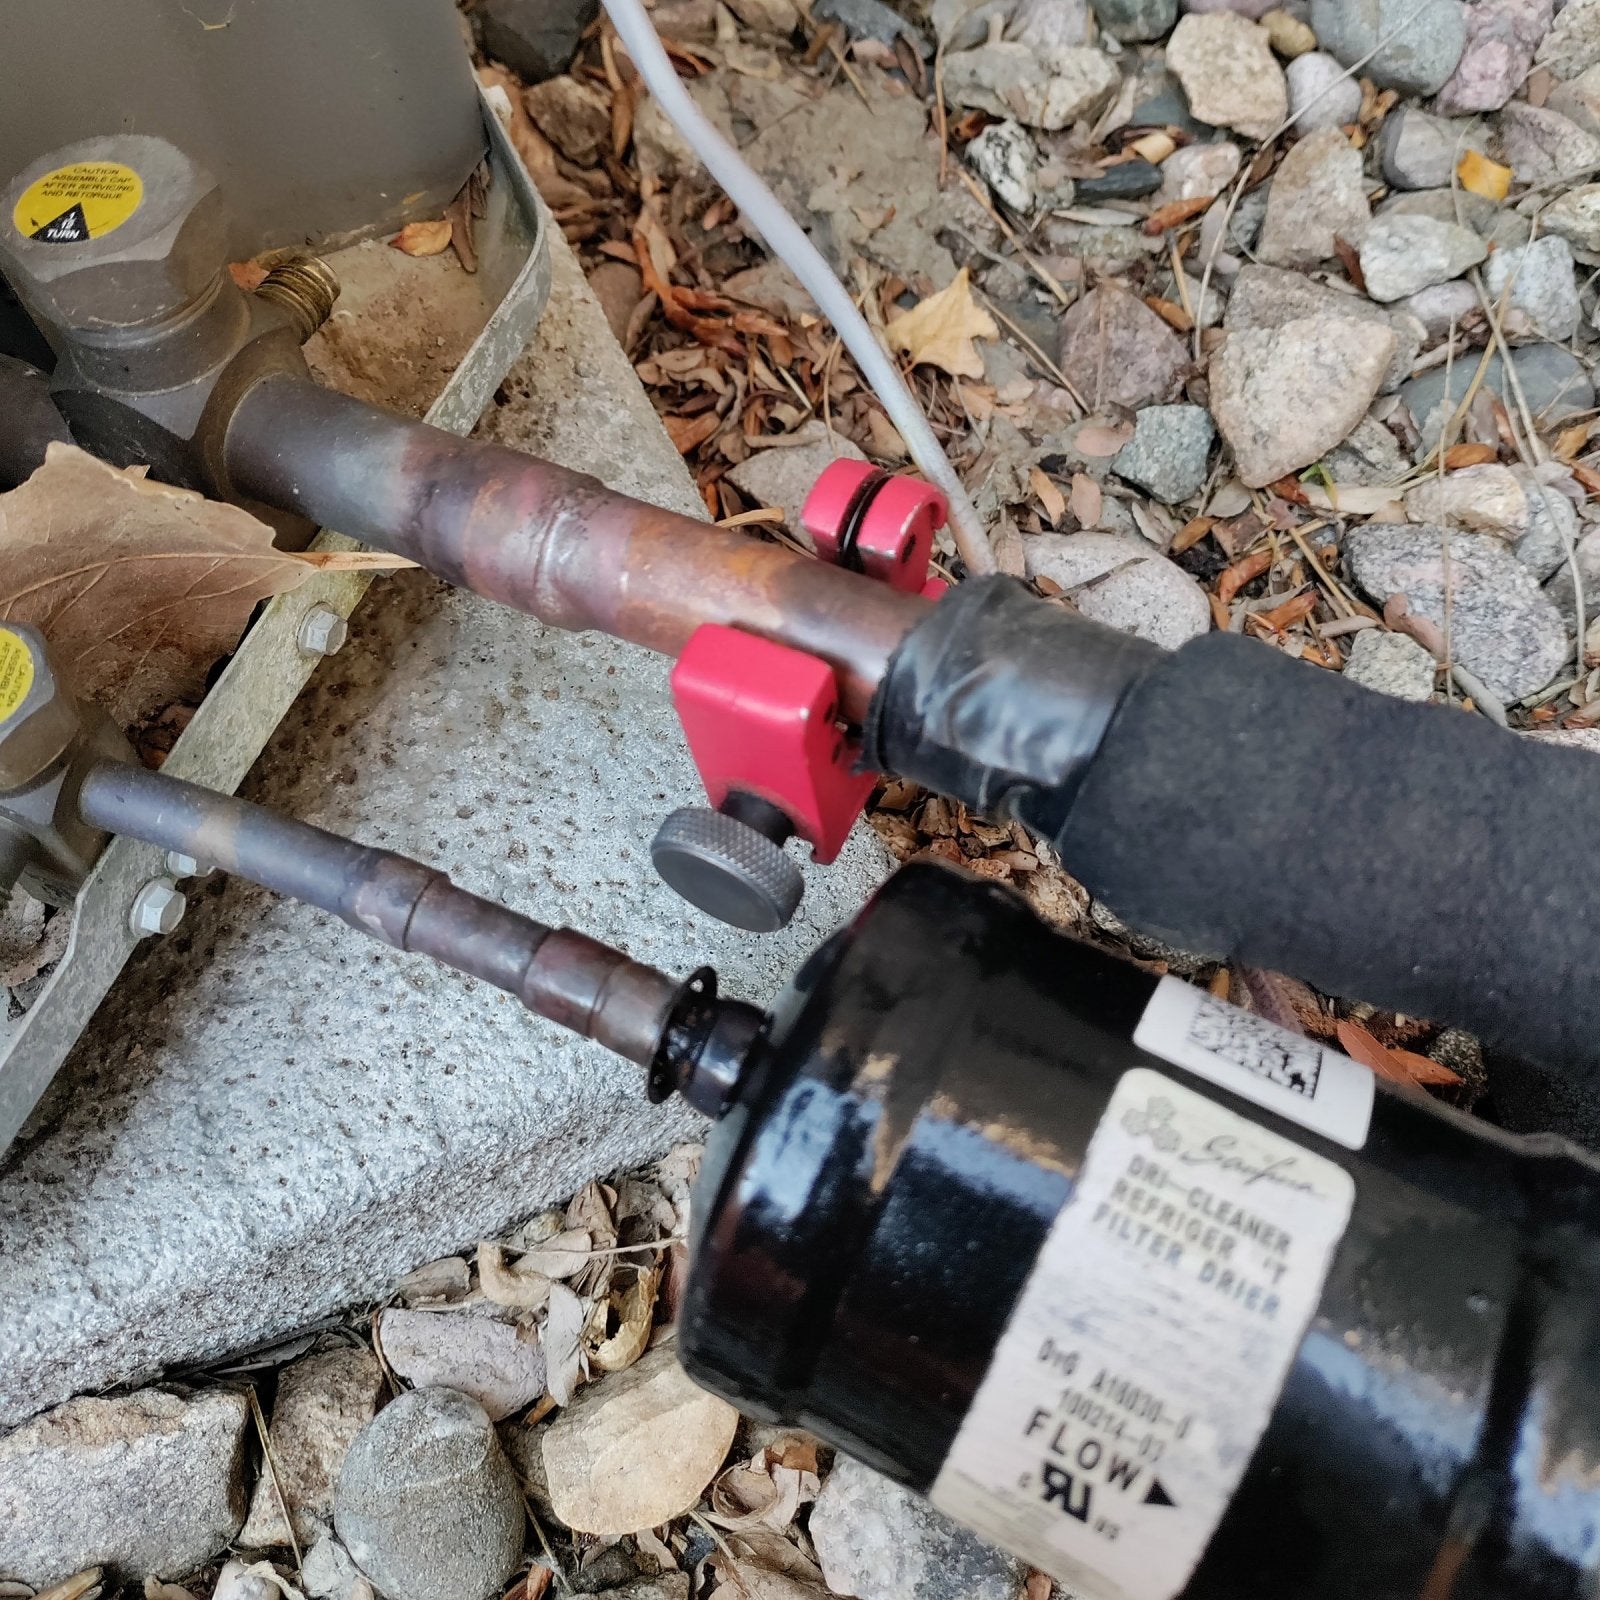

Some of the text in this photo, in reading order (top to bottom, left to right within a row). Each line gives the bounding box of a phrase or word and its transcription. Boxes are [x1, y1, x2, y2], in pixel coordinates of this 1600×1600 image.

[73, 167, 120, 175] CAUTION
[52, 174, 107, 182] ASSEMBLE
[78, 183, 135, 192] SERVICING
[65, 191, 122, 199] RETORQUE
[47, 228, 80, 239] TURN
[1127, 1153, 1291, 1254] DRI-CLEANER
[1111, 1177, 1287, 1285] REFRIGERT
[1092, 1201, 1281, 1319] FILTER DRIER
[1023, 1405, 1141, 1492] FLOW
